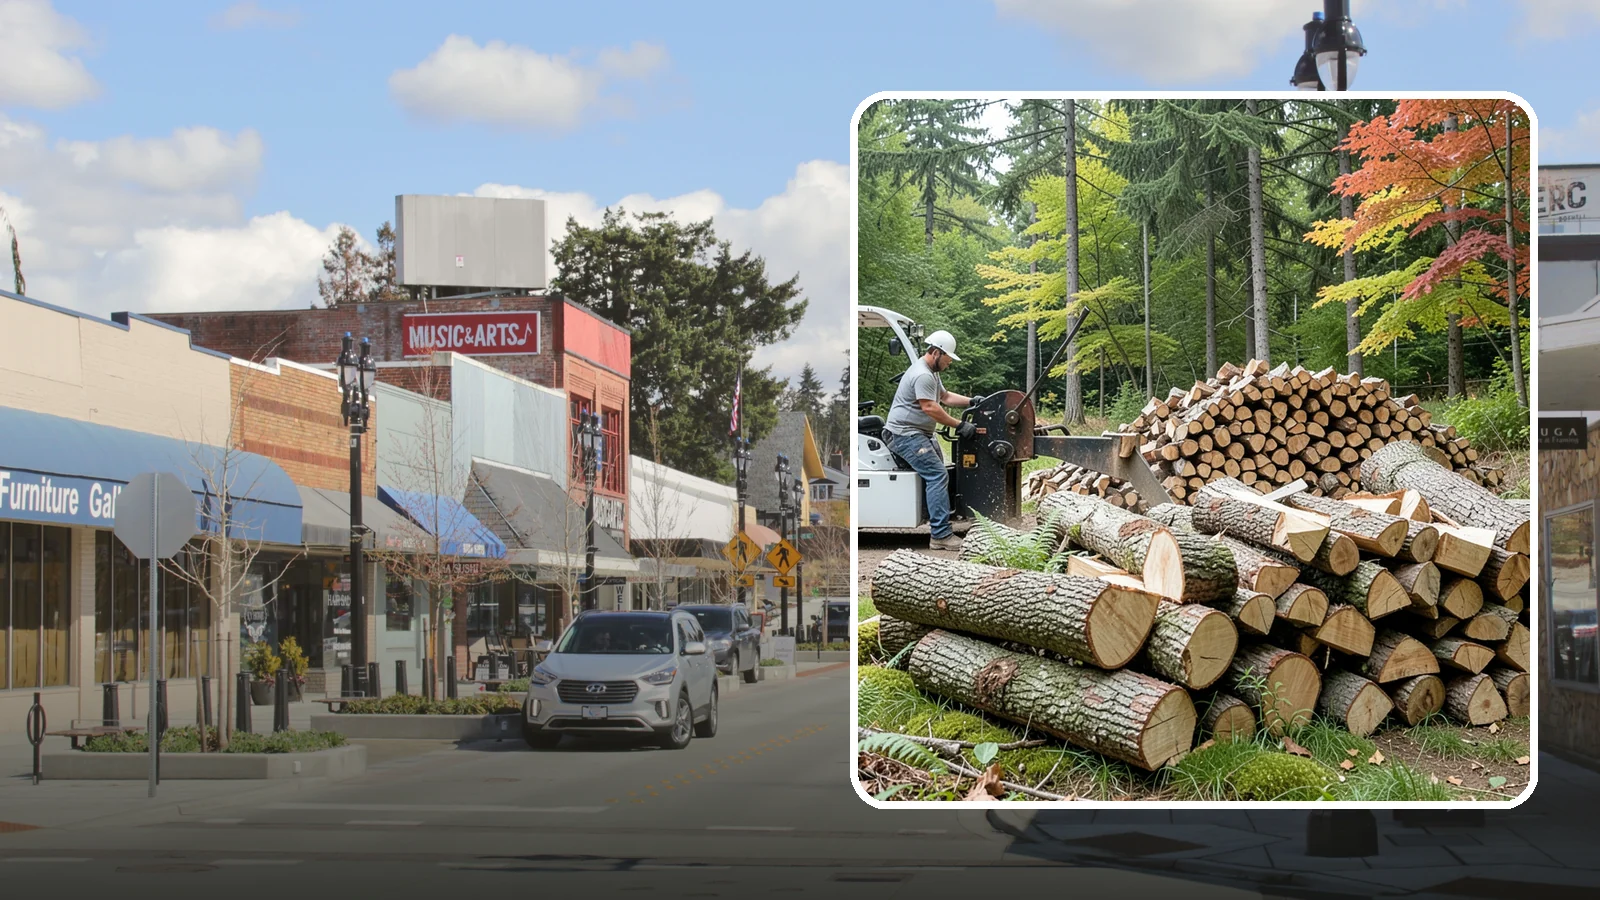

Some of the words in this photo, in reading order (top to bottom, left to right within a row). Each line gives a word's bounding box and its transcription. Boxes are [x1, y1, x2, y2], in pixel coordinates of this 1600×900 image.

[0, 471, 79, 516] Furniture
[89, 482, 122, 519] Gal
[453, 563, 479, 574] SUSHI
